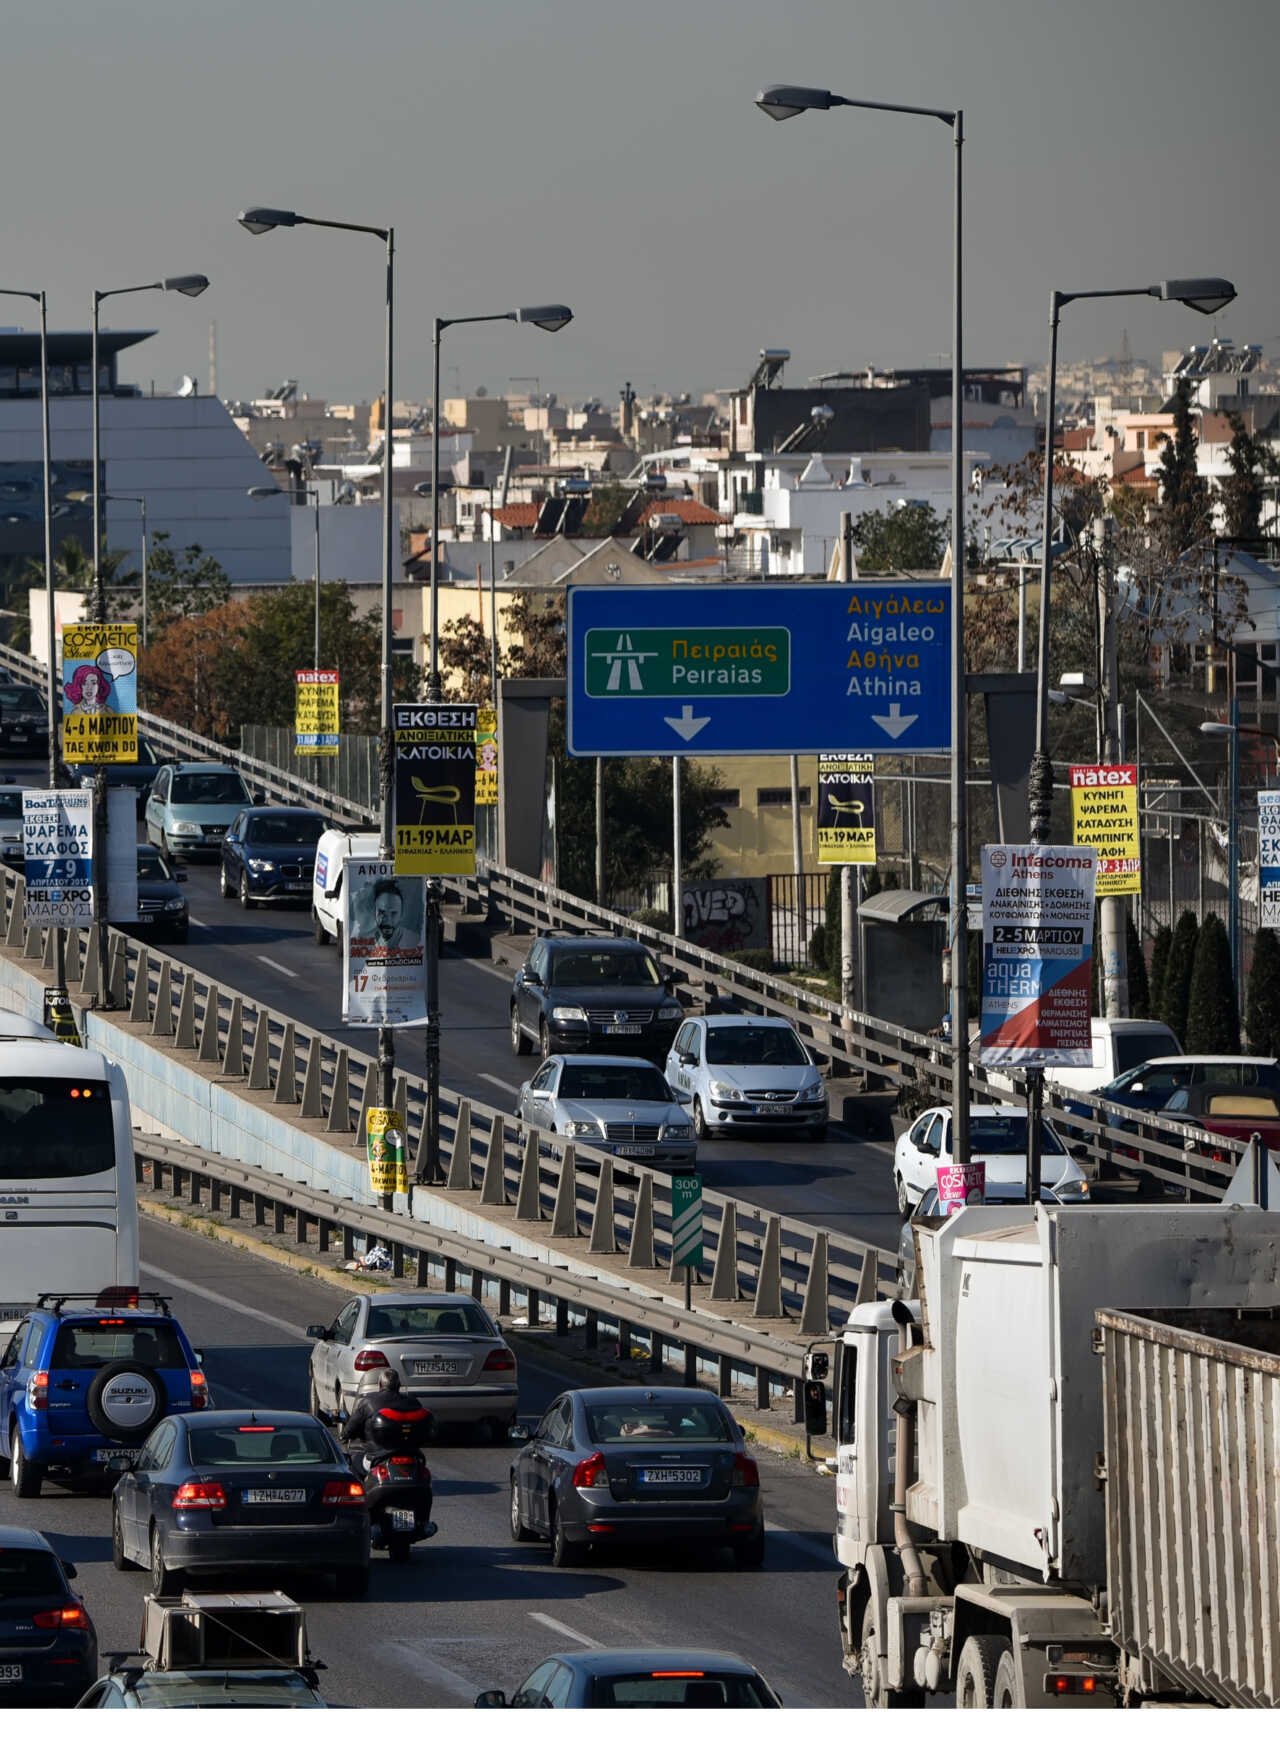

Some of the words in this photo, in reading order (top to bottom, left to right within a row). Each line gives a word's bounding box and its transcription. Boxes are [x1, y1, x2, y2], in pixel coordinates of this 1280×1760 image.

[847, 596, 944, 619] Αιγάλεω
[64, 632, 136, 647] COSMETIC
[847, 622, 934, 646] Aigaleo
[672, 639, 777, 662] Πειραιάς
[847, 650, 919, 672] Αθήνα
[297, 672, 337, 683] natex
[672, 665, 763, 684] Peiraias
[846, 676, 921, 696] Athina
[397, 711, 475, 727] ΕΚΘΕΣΗ
[65, 717, 85, 736] 4-6
[89, 717, 135, 736] ΜΑΡΤΙΟΥ
[300, 723, 335, 732] ΣΚΑΦΗ
[398, 730, 475, 742] ΑΝΟΙΞΙΑΤΙΚΗ
[397, 746, 475, 760] ΚΑΤΟΙΚΙΑ
[820, 773, 873, 784] ΚΑΤΟΙΚΙΑ
[1073, 770, 1132, 786] natex
[1084, 790, 1124, 800] ΚΥΝΗΓΙ
[1081, 804, 1128, 815] ΨΑΡΕΜΑ
[25, 814, 60, 824] ΕΚΘΕΣΗ
[1077, 818, 1133, 829] ΚΑΤΑΔΥΣΗ
[25, 824, 88, 838] ΨΑΡΕΜΑ
[819, 831, 845, 843] 11-19
[847, 831, 873, 843] ΜΑΡ
[398, 829, 435, 846] 11-19
[436, 829, 473, 845] ΜΑΡ
[1077, 832, 1134, 843] ΚΑΜΠΙΝΓΚ
[25, 841, 88, 855] ΣΚΑΦΟΣ
[1011, 852, 1093, 869] Infacoma
[43, 859, 77, 878] 7-9
[1011, 868, 1054, 880] Athens
[30, 879, 70, 887] ΑΠΡΙΛΙΟΥ
[27, 890, 91, 902] HELEXPO
[995, 887, 1041, 898] ΔΙΕΘΝΗΣ
[1045, 888, 1085, 899] ΕΚΘΕΣΗ
[27, 903, 92, 916] ΜΑΡΟΥΣΙ
[990, 900, 1044, 909] ΑΝΑΚΑΙΝΙΣΗΣ
[1049, 901, 1091, 910] ΔΟΜΗΣΗΣ
[990, 911, 1045, 920] ΚΟΥΦΩΜΑΤΩΝ
[1049, 912, 1091, 921] ΜΟΝΩΣΗΣ
[1024, 928, 1081, 943] ΜΑΡΤΙΟΥ
[996, 946, 1036, 955] HELEXPO
[987, 962, 1032, 982] aqua
[354, 976, 368, 992] 17
[988, 980, 1043, 995] THERM
[1048, 989, 1088, 998] ΔΙΕΘΝΗΣ
[988, 1001, 1017, 1009] ATHENS
[1053, 999, 1088, 1007] ΕΚΘΕΣΗ
[1041, 1009, 1088, 1018] ΘΕΡΜΑΝΣΗΣ
[1036, 1019, 1088, 1028] ΚΛΙΜΑΤΙΣΜΟΥ
[1050, 1029, 1089, 1038] ΕΝΕΡΓΕΙΑΣ
[1056, 1039, 1089, 1048] ΠΙΣΙΝΑΣ
[675, 1179, 699, 1190] 300
[682, 1190, 693, 1198] m
[110, 1387, 147, 1395] SUZUKI
